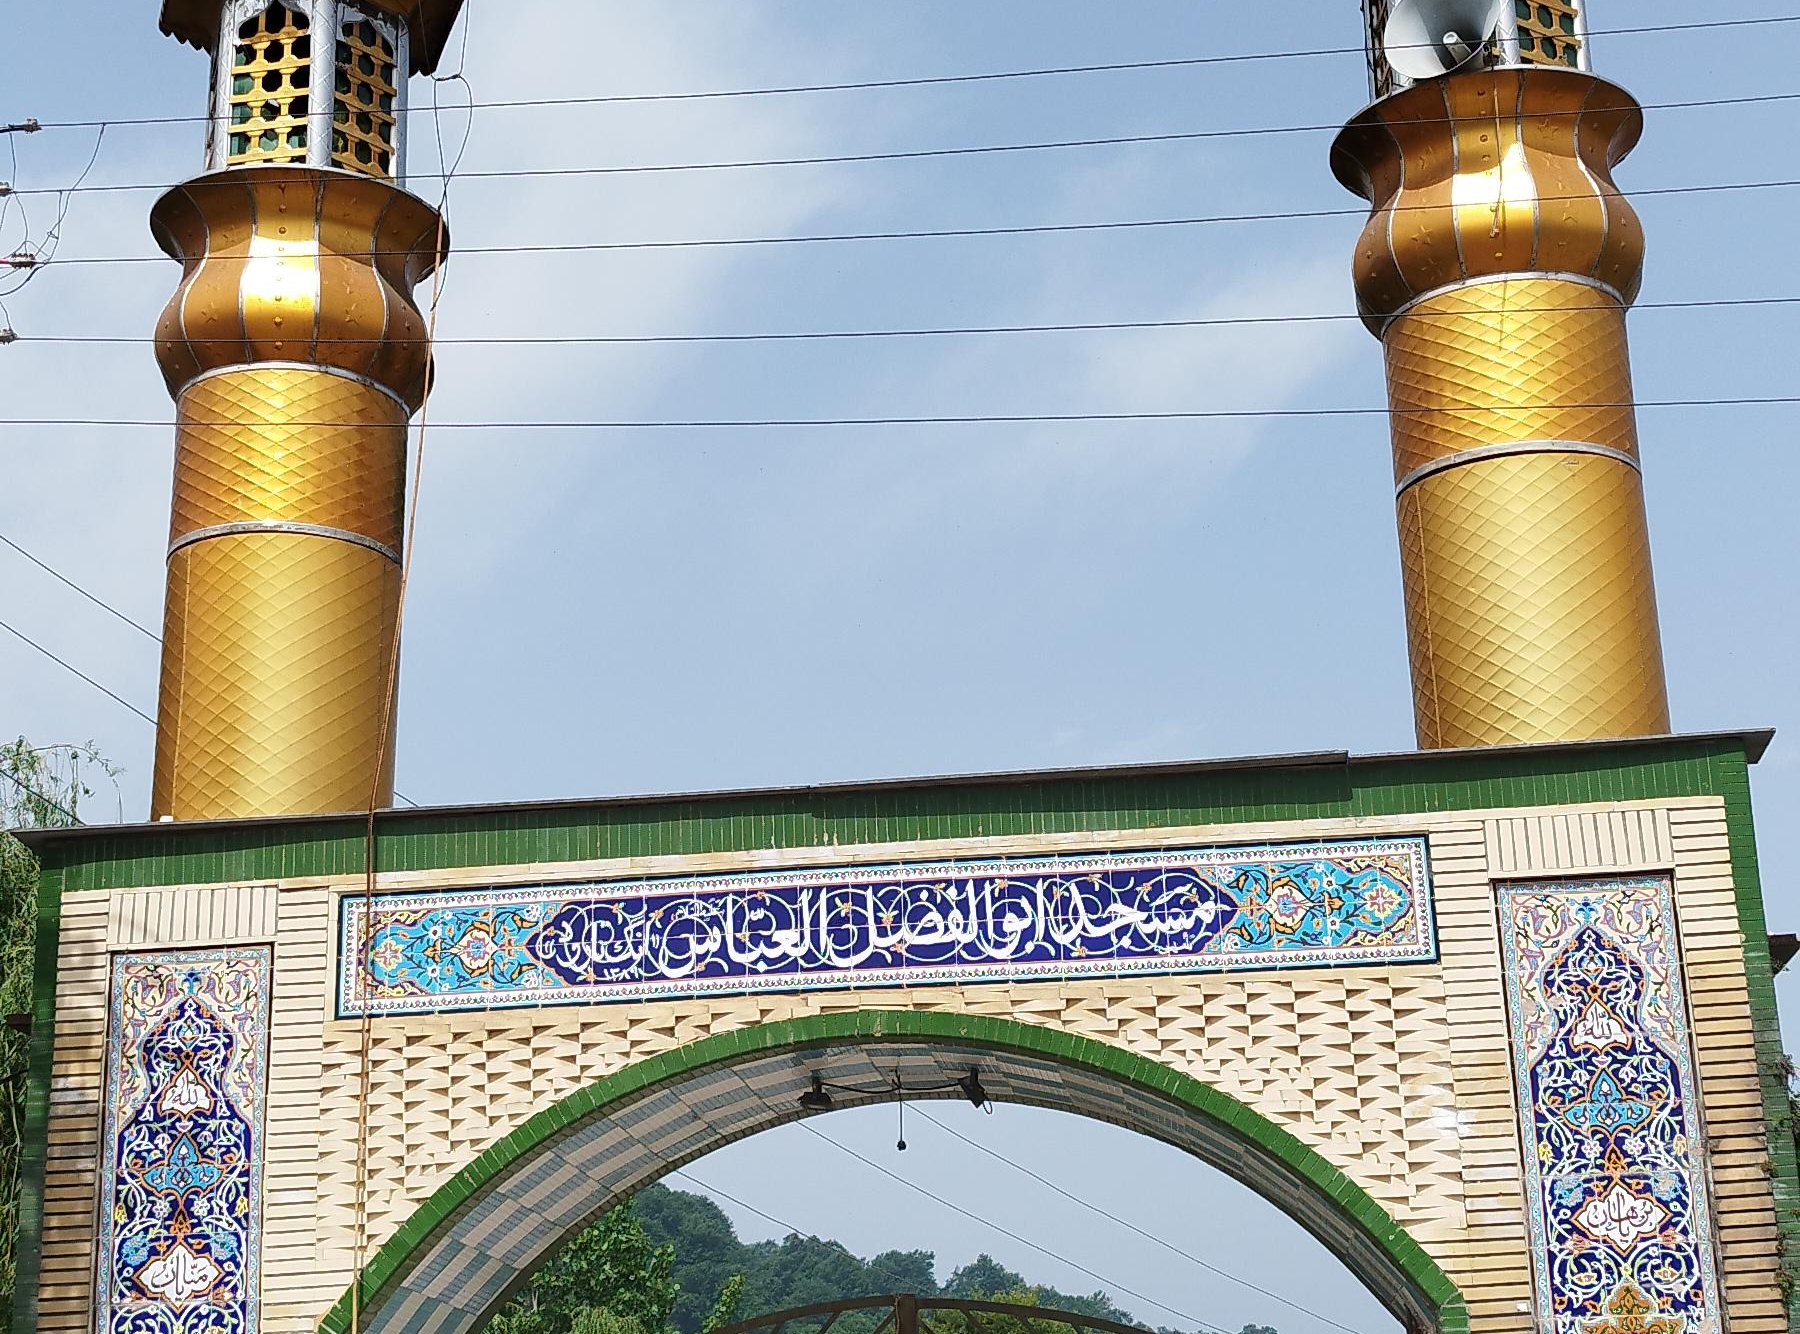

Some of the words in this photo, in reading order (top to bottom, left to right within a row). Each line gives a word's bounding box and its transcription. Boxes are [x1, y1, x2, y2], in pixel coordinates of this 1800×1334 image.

[659, 887, 827, 979] العباس
[1049, 881, 1215, 950] مسجد
[1584, 1004, 1613, 1040] الله
[168, 1071, 199, 1106] الله
